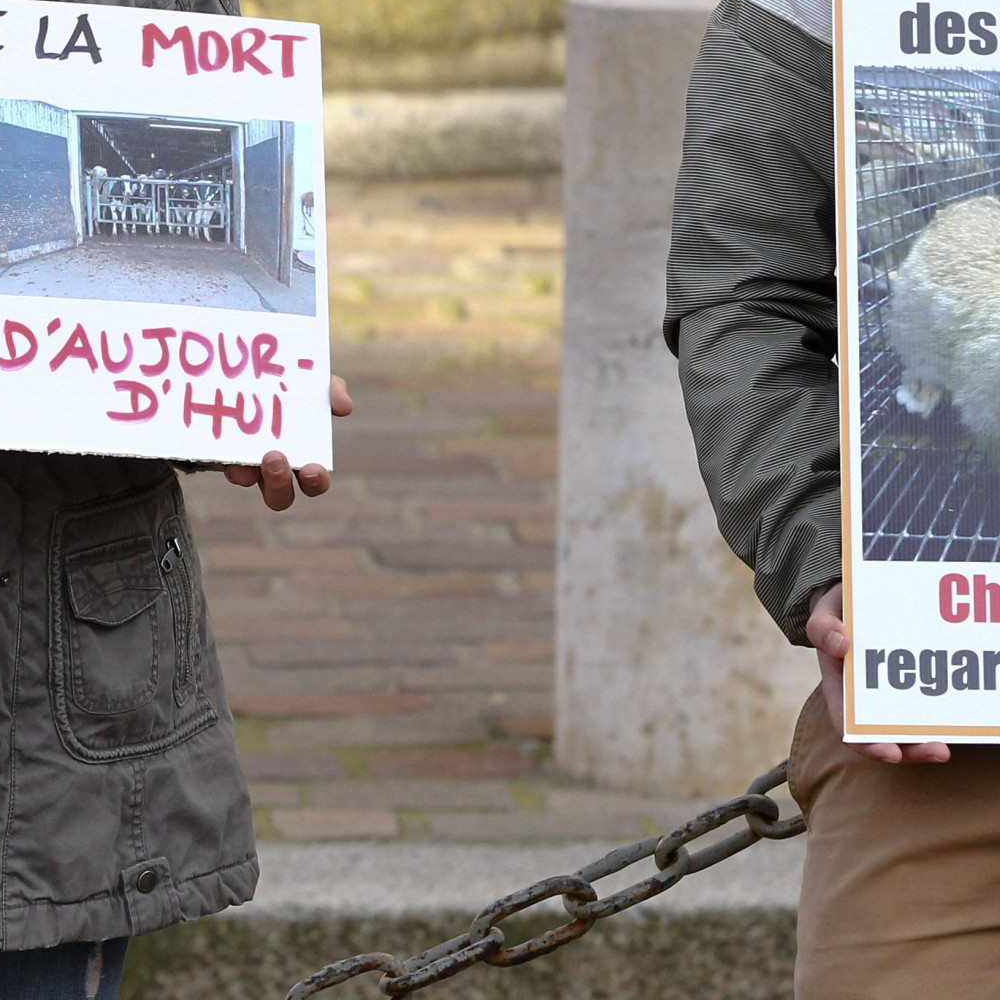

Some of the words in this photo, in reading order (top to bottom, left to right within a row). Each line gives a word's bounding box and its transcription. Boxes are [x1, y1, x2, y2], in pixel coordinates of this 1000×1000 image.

[35, 14, 102, 64] LA
[141, 22, 310, 79] MORT
[900, 2, 998, 55] des
[939, 573, 1000, 623] Ch
[865, 649, 1000, 697] regar
